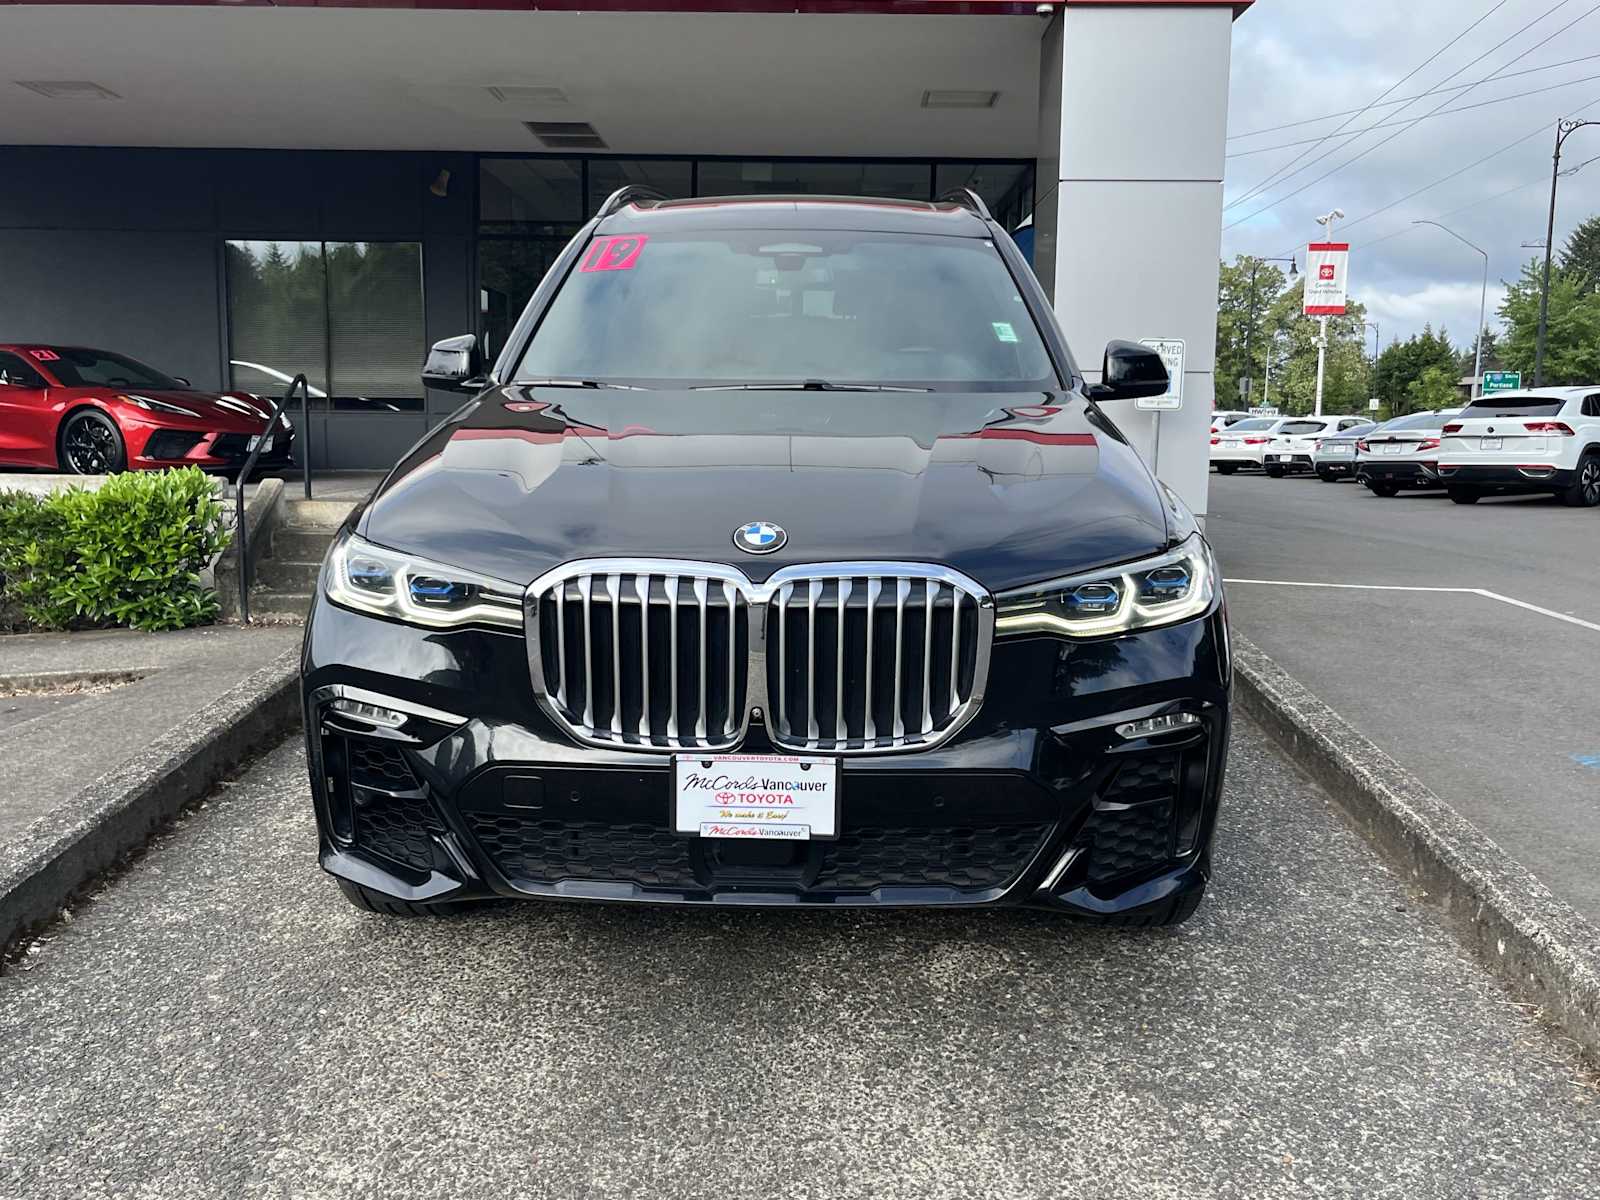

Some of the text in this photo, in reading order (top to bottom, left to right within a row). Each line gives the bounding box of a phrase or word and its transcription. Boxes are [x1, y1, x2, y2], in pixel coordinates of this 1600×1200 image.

[586, 239, 637, 267] 19
[761, 778, 828, 792] Vancouver
[738, 793, 794, 804] TOYOTA
